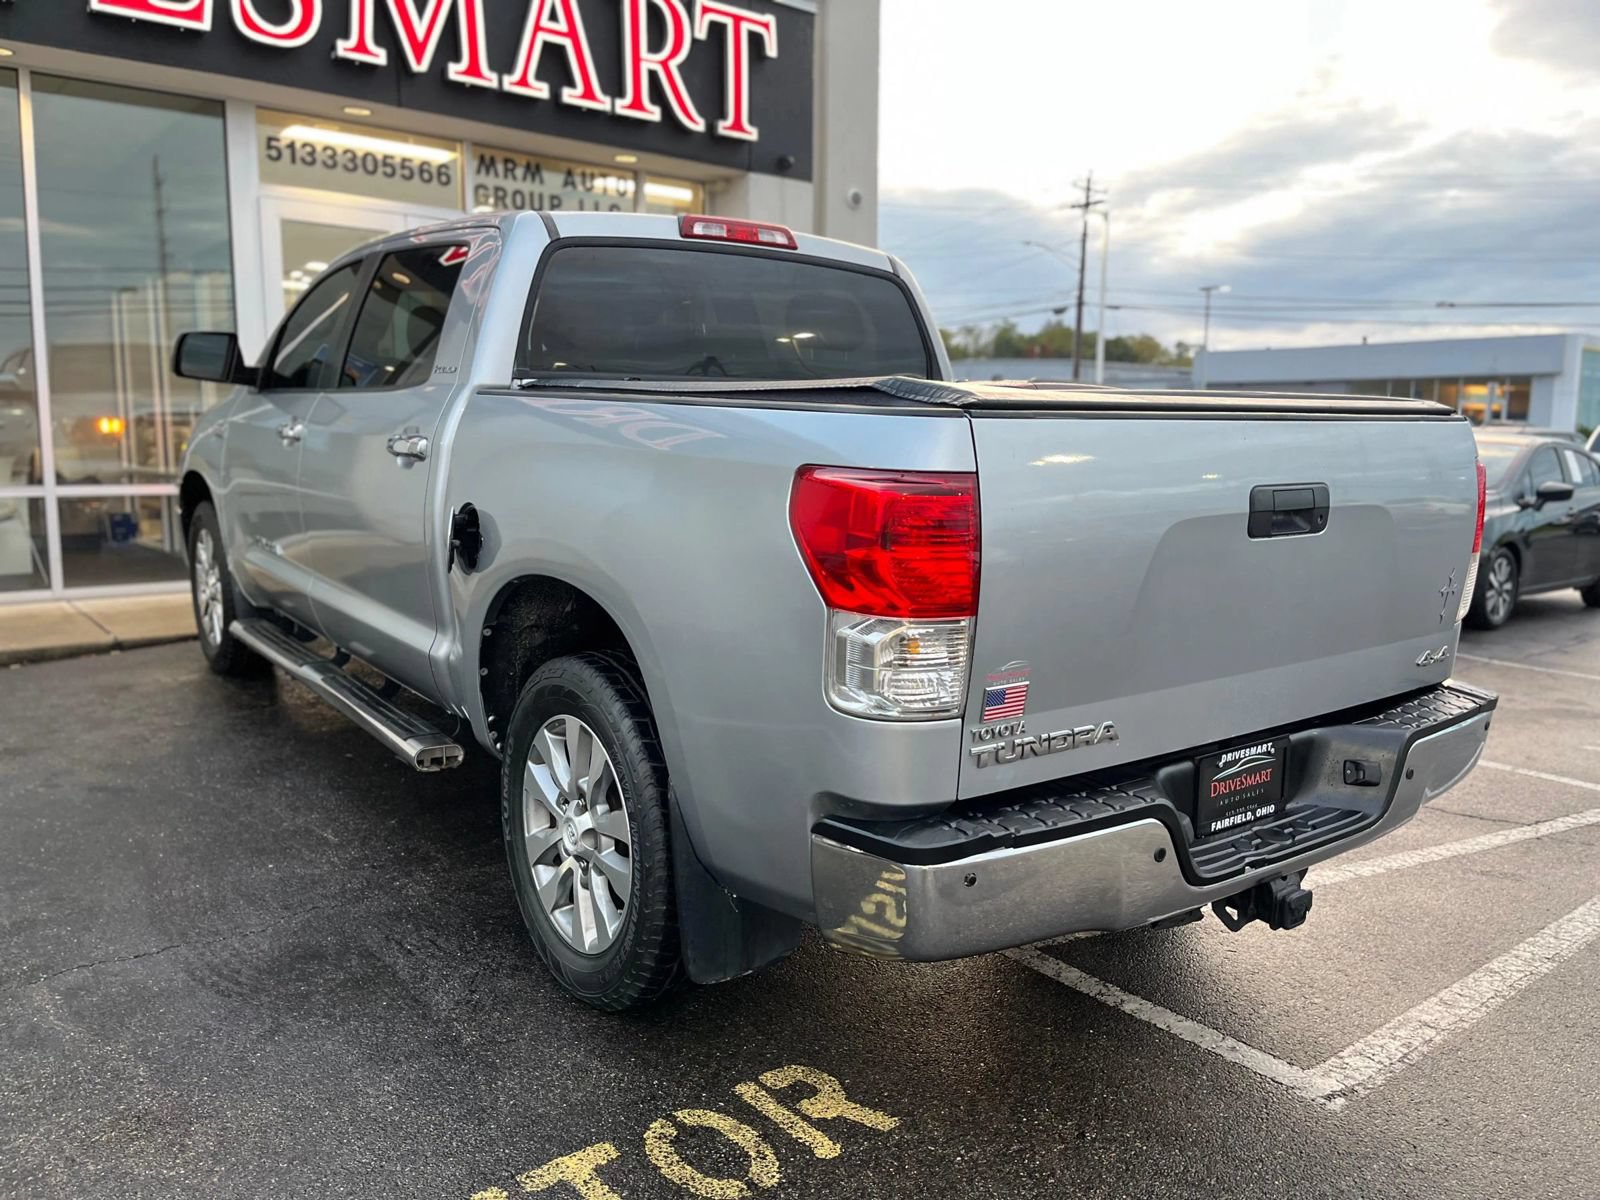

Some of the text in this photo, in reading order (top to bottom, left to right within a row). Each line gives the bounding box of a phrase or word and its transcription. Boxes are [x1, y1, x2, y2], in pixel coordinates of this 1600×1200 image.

[266, 136, 452, 186] 5133305566
[476, 153, 545, 185] MRM
[474, 184, 562, 212] GROUP
[970, 720, 1120, 769] TUNDRA
[971, 720, 1026, 743] TOYOTA
[1220, 742, 1273, 764] DRIVESMART
[1210, 811, 1255, 832] FAIRFIELD,
[1256, 804, 1275, 818] OHIO
[470, 1065, 900, 1200] TOR
